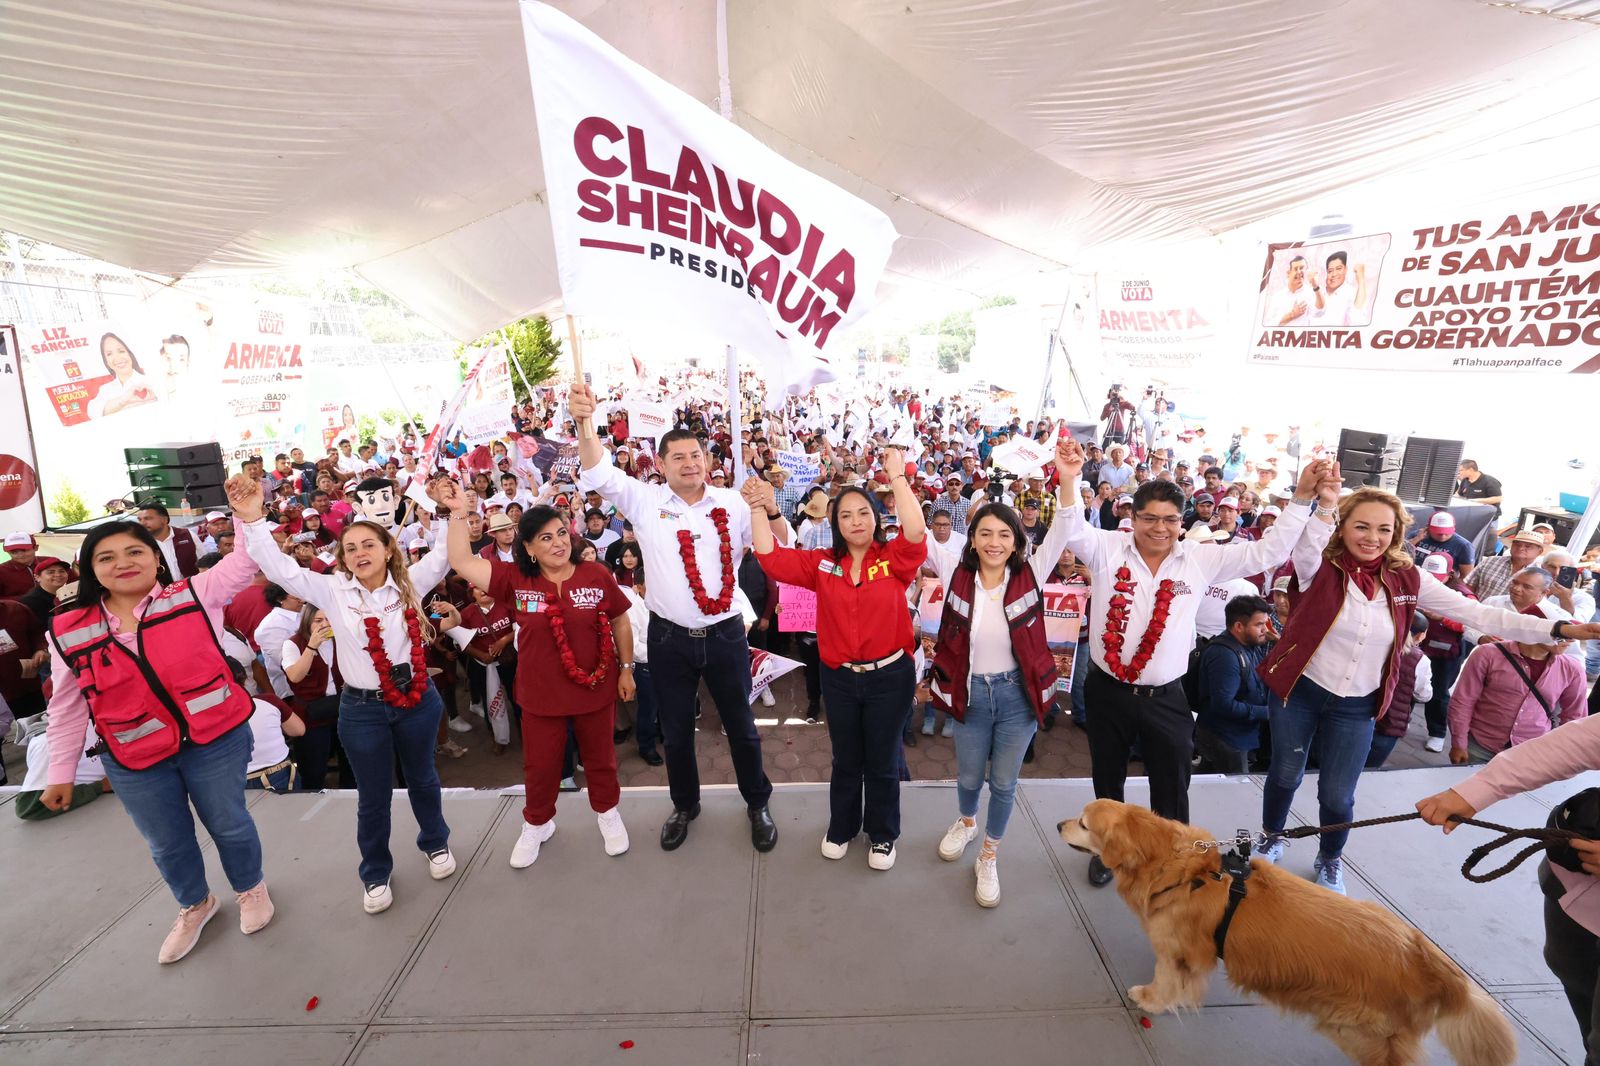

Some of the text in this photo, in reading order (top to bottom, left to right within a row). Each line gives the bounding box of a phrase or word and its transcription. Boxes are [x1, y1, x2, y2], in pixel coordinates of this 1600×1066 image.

[573, 116, 856, 314] CLAUDIA
[1412, 220, 1482, 250] TUS
[1401, 233, 1600, 276] DE SAN JU
[1121, 288, 1152, 300] VOTA
[1394, 268, 1600, 308] CUAUHTÉM
[1100, 306, 1211, 332] ARMENTA
[1408, 298, 1600, 327] APOYO TOTA
[42, 326, 70, 342] LIZ
[1256, 330, 1363, 348] ARMENTA
[1452, 357, 1563, 368] #Tlahuapanpalface
[868, 560, 890, 581] PT
